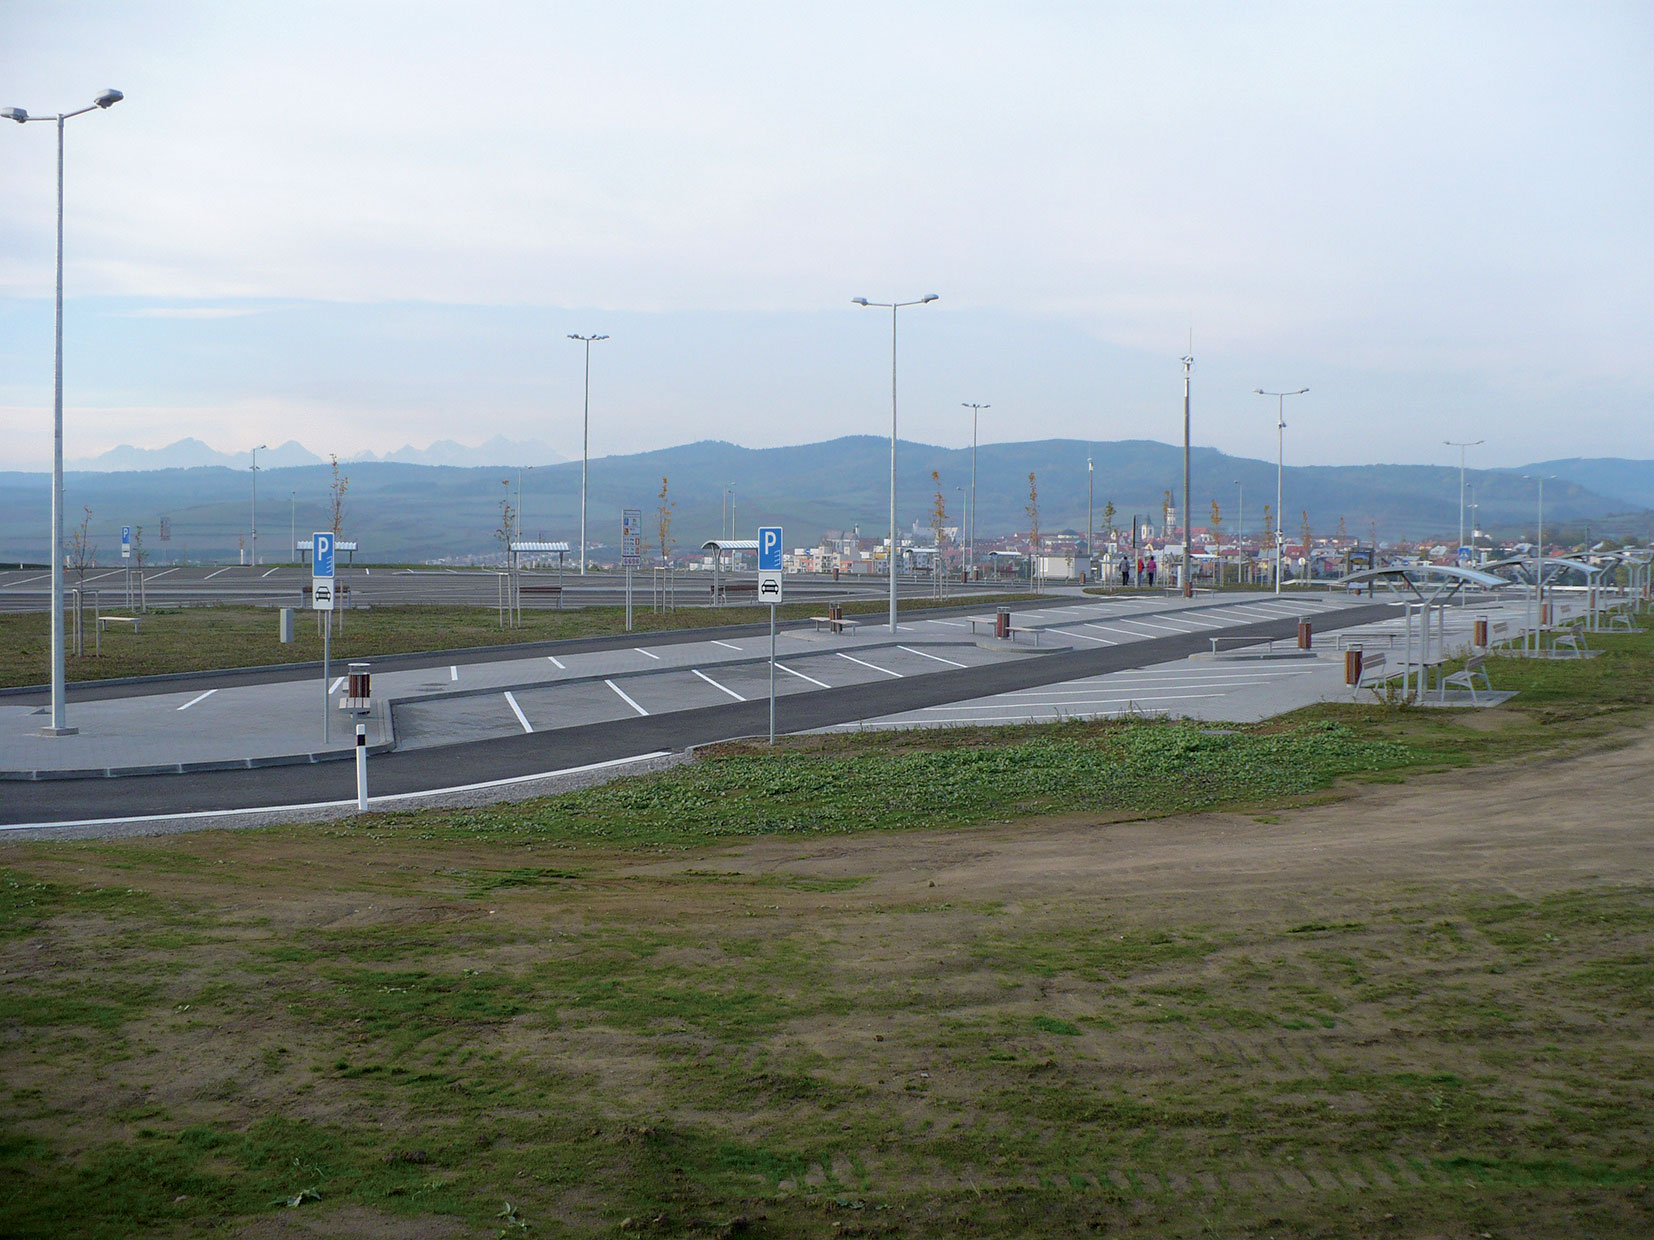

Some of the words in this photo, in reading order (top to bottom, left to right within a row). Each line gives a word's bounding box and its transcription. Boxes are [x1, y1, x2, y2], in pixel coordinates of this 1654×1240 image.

[123, 528, 129, 538] P
[765, 531, 776, 555] P
[318, 537, 329, 560] P
